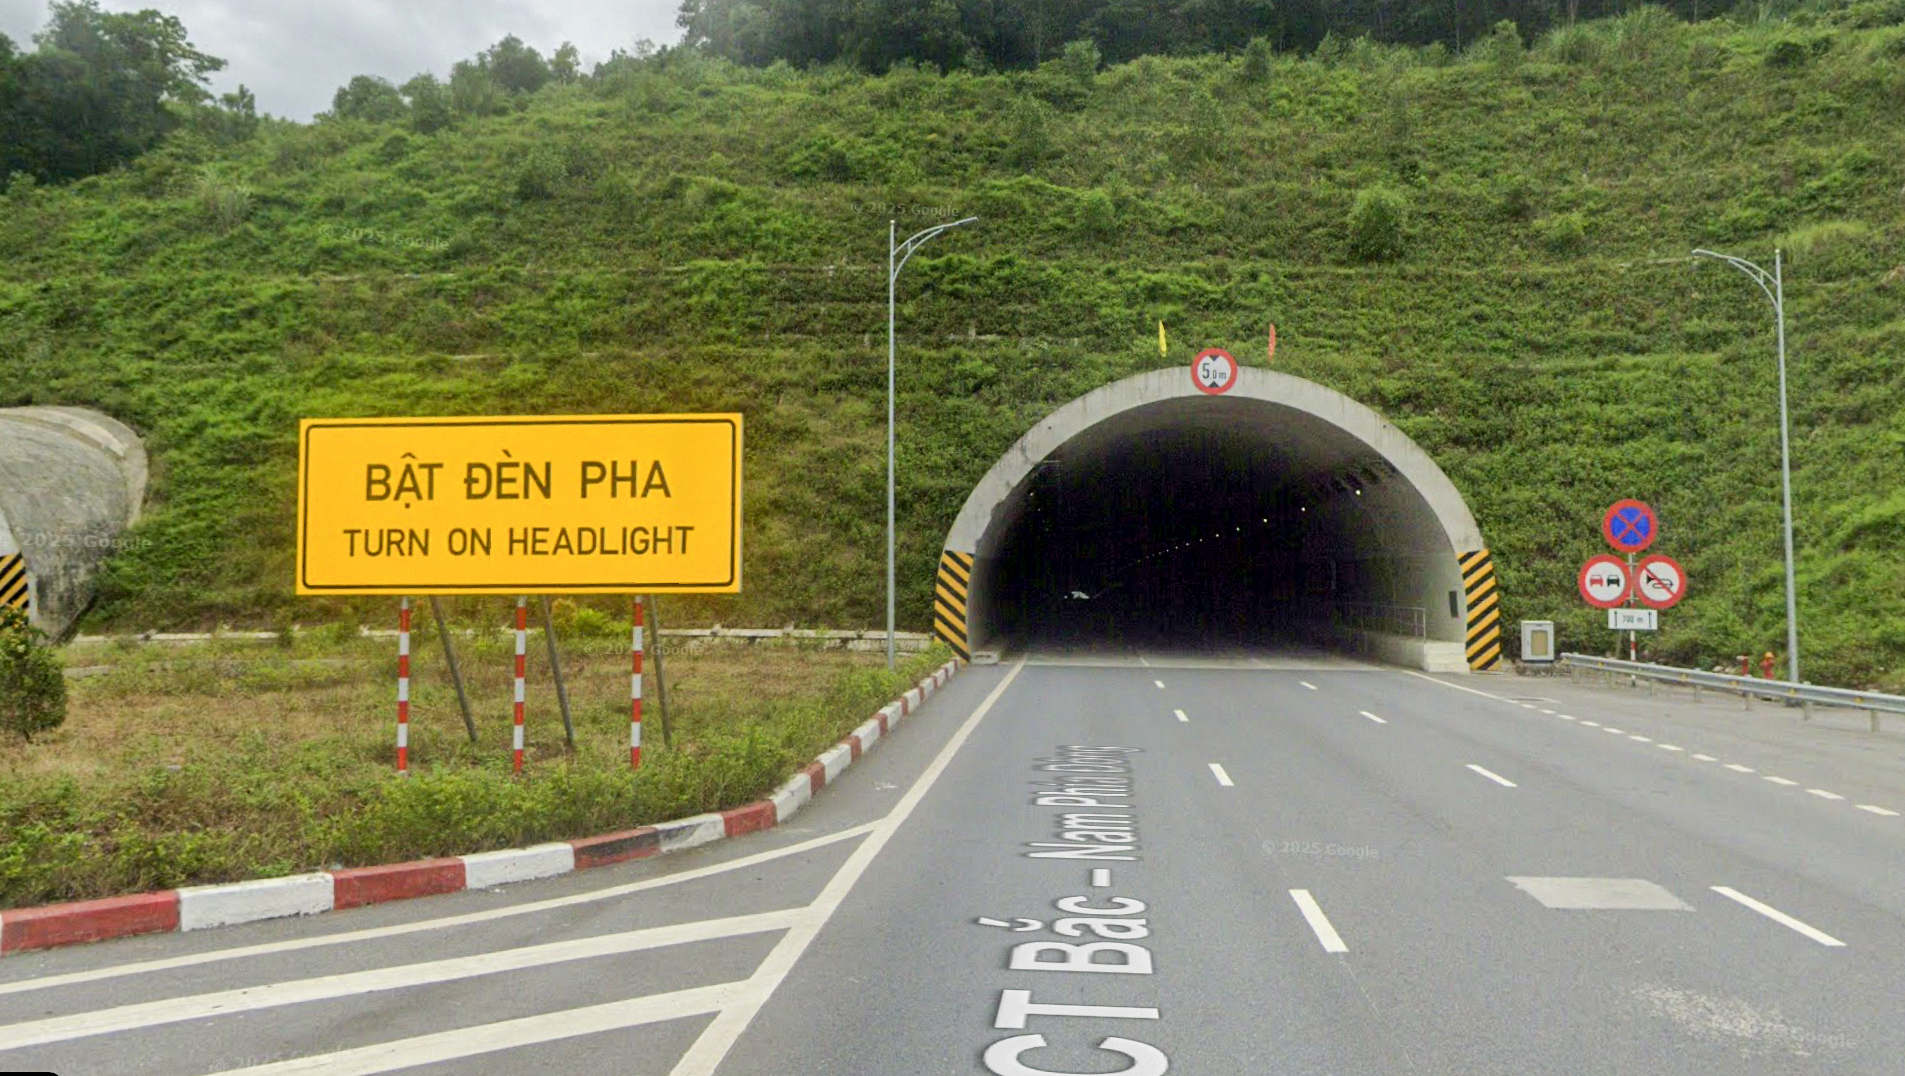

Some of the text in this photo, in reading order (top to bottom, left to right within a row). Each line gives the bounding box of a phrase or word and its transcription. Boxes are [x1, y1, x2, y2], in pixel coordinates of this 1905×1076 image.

[365, 448, 672, 509] BẬT ĐÈN PHA
[343, 525, 695, 557] TURN ON HEADLIGHT
